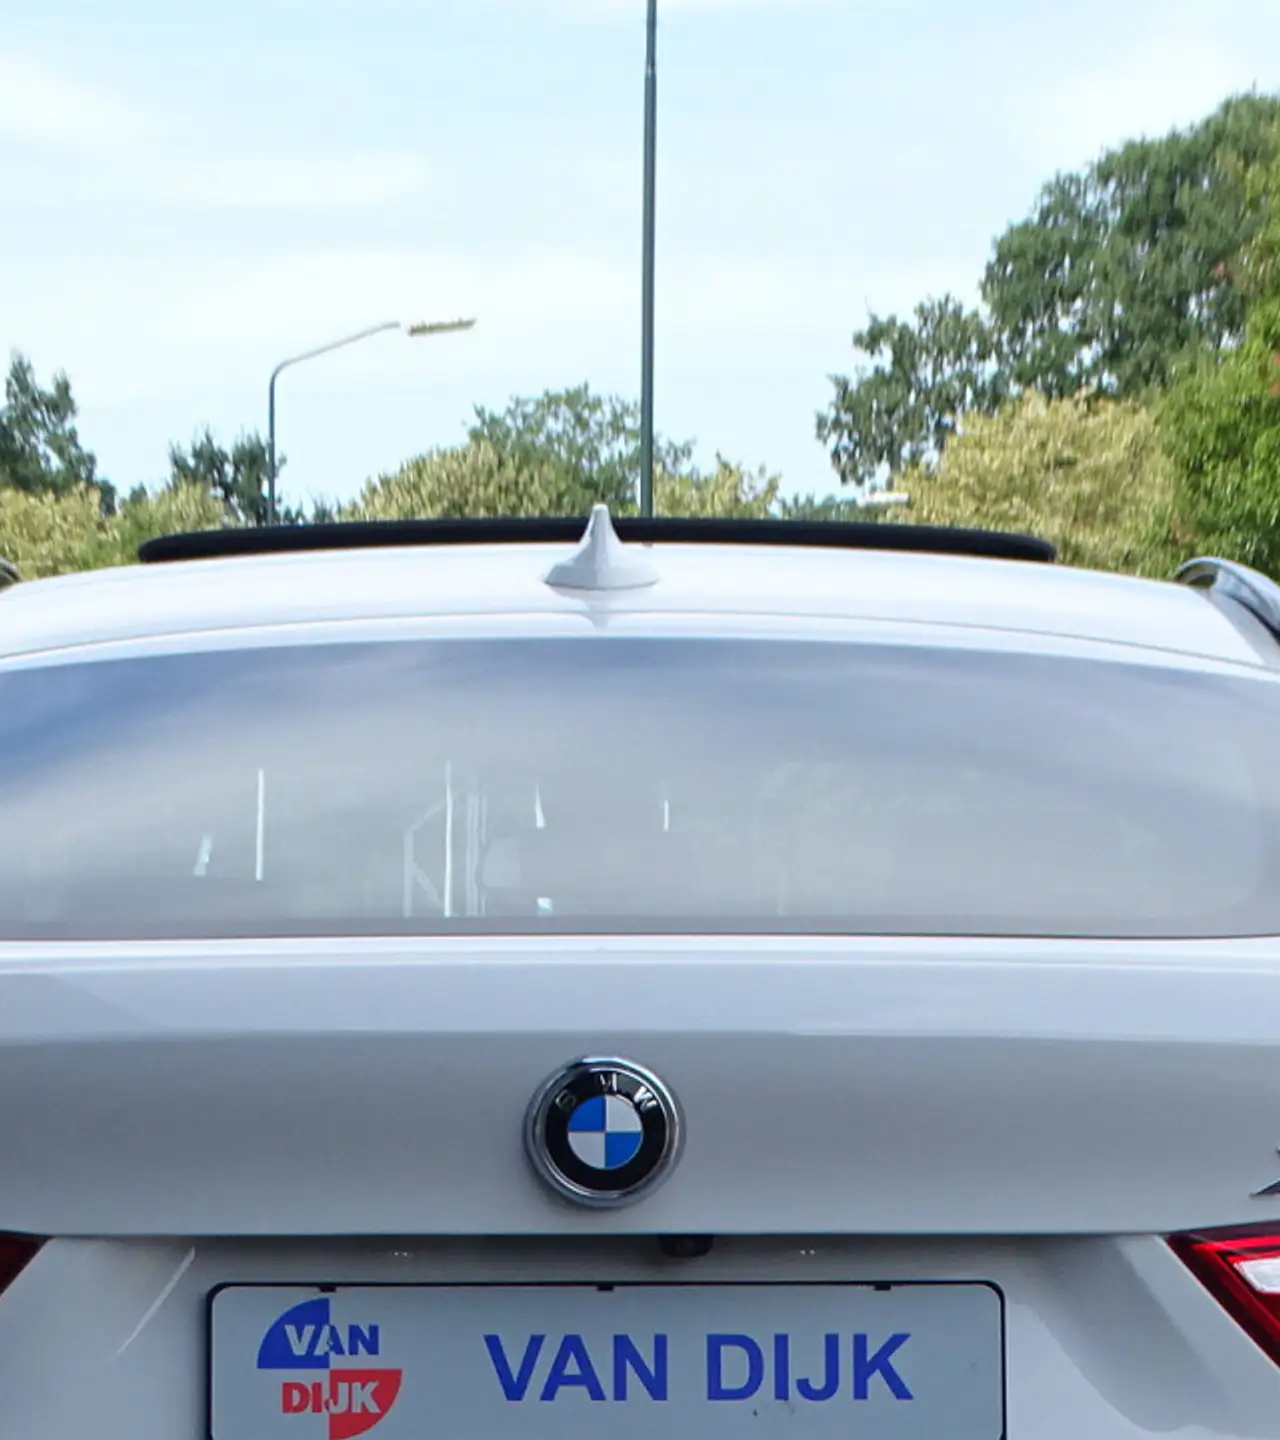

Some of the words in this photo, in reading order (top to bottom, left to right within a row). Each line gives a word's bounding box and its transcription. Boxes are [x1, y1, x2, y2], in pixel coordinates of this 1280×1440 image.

[555, 1072, 658, 1113] BMW
[283, 1324, 380, 1356] VAN
[483, 1333, 668, 1401] VAN
[706, 1333, 914, 1401] DIJK
[281, 1381, 382, 1414] DIJK
